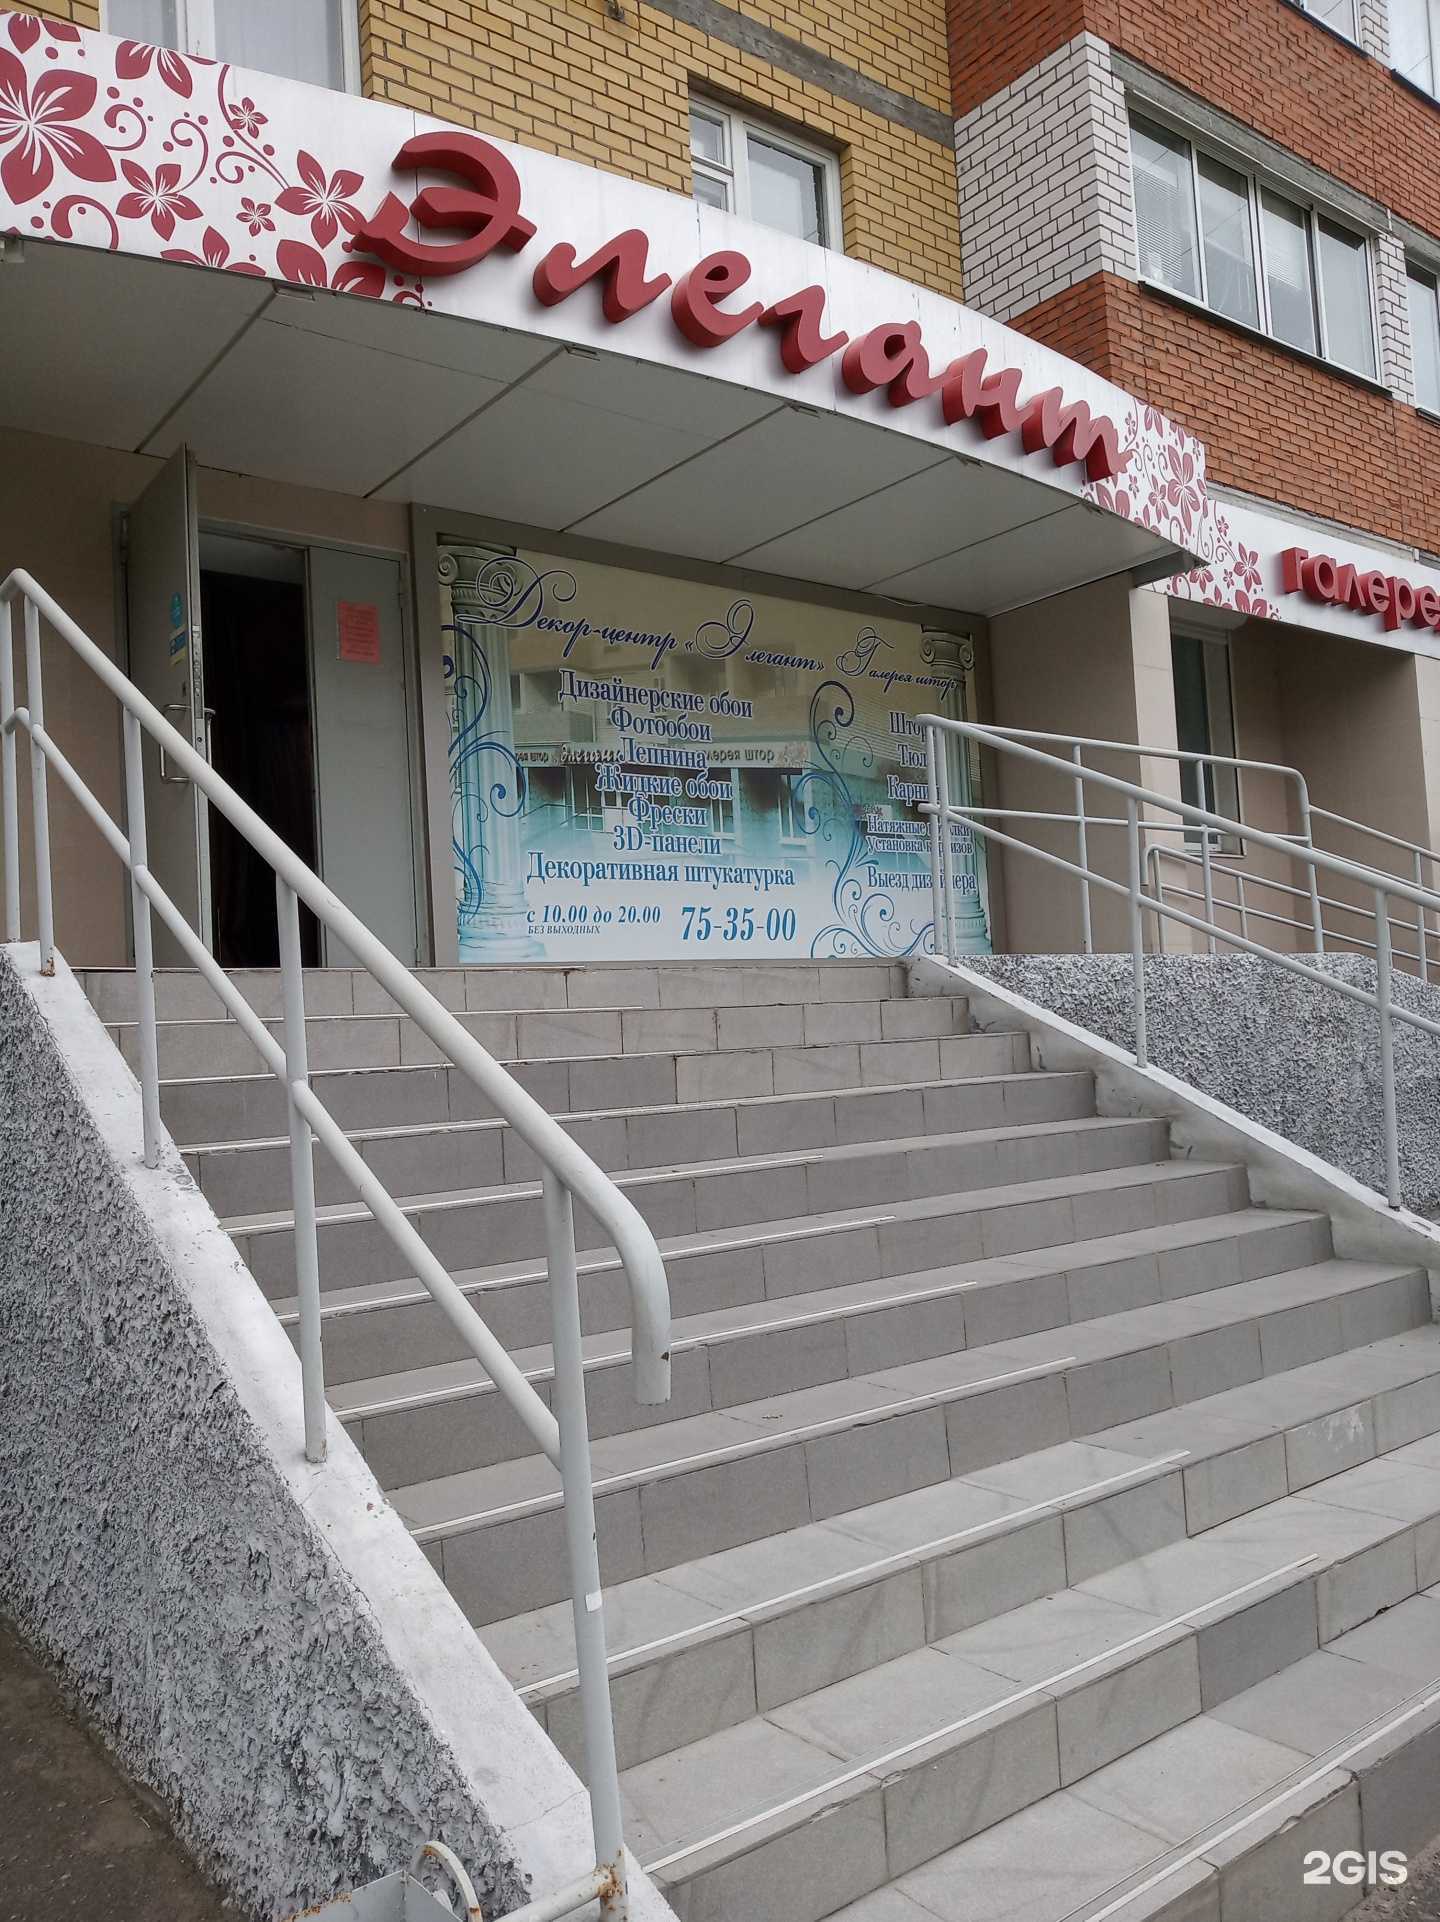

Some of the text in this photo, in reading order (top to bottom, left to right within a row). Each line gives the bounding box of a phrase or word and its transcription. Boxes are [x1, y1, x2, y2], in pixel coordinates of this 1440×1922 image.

[353, 131, 1132, 482] Элегант
[1281, 547, 1440, 633] галере
[455, 556, 678, 670] Декор-центр
[836, 626, 959, 700] Галерея штор
[559, 669, 753, 718] Дизайнерские обои
[610, 705, 712, 741] Фотообои
[618, 737, 708, 769] Лепнина
[898, 743, 929, 768] Тюл
[595, 763, 732, 800] Жидкие обои
[628, 794, 708, 829] Фрески
[866, 814, 926, 836] Натяжные
[613, 825, 721, 855] 3D-панели
[526, 850, 796, 891] Декоративная штукатурка
[867, 864, 910, 893] Выезд
[526, 904, 661, 924] с 10.00 до 20.00
[527, 924, 601, 937] БЕЗ ВЫХОДНЫХ
[680, 906, 797, 942] 75-35-00
